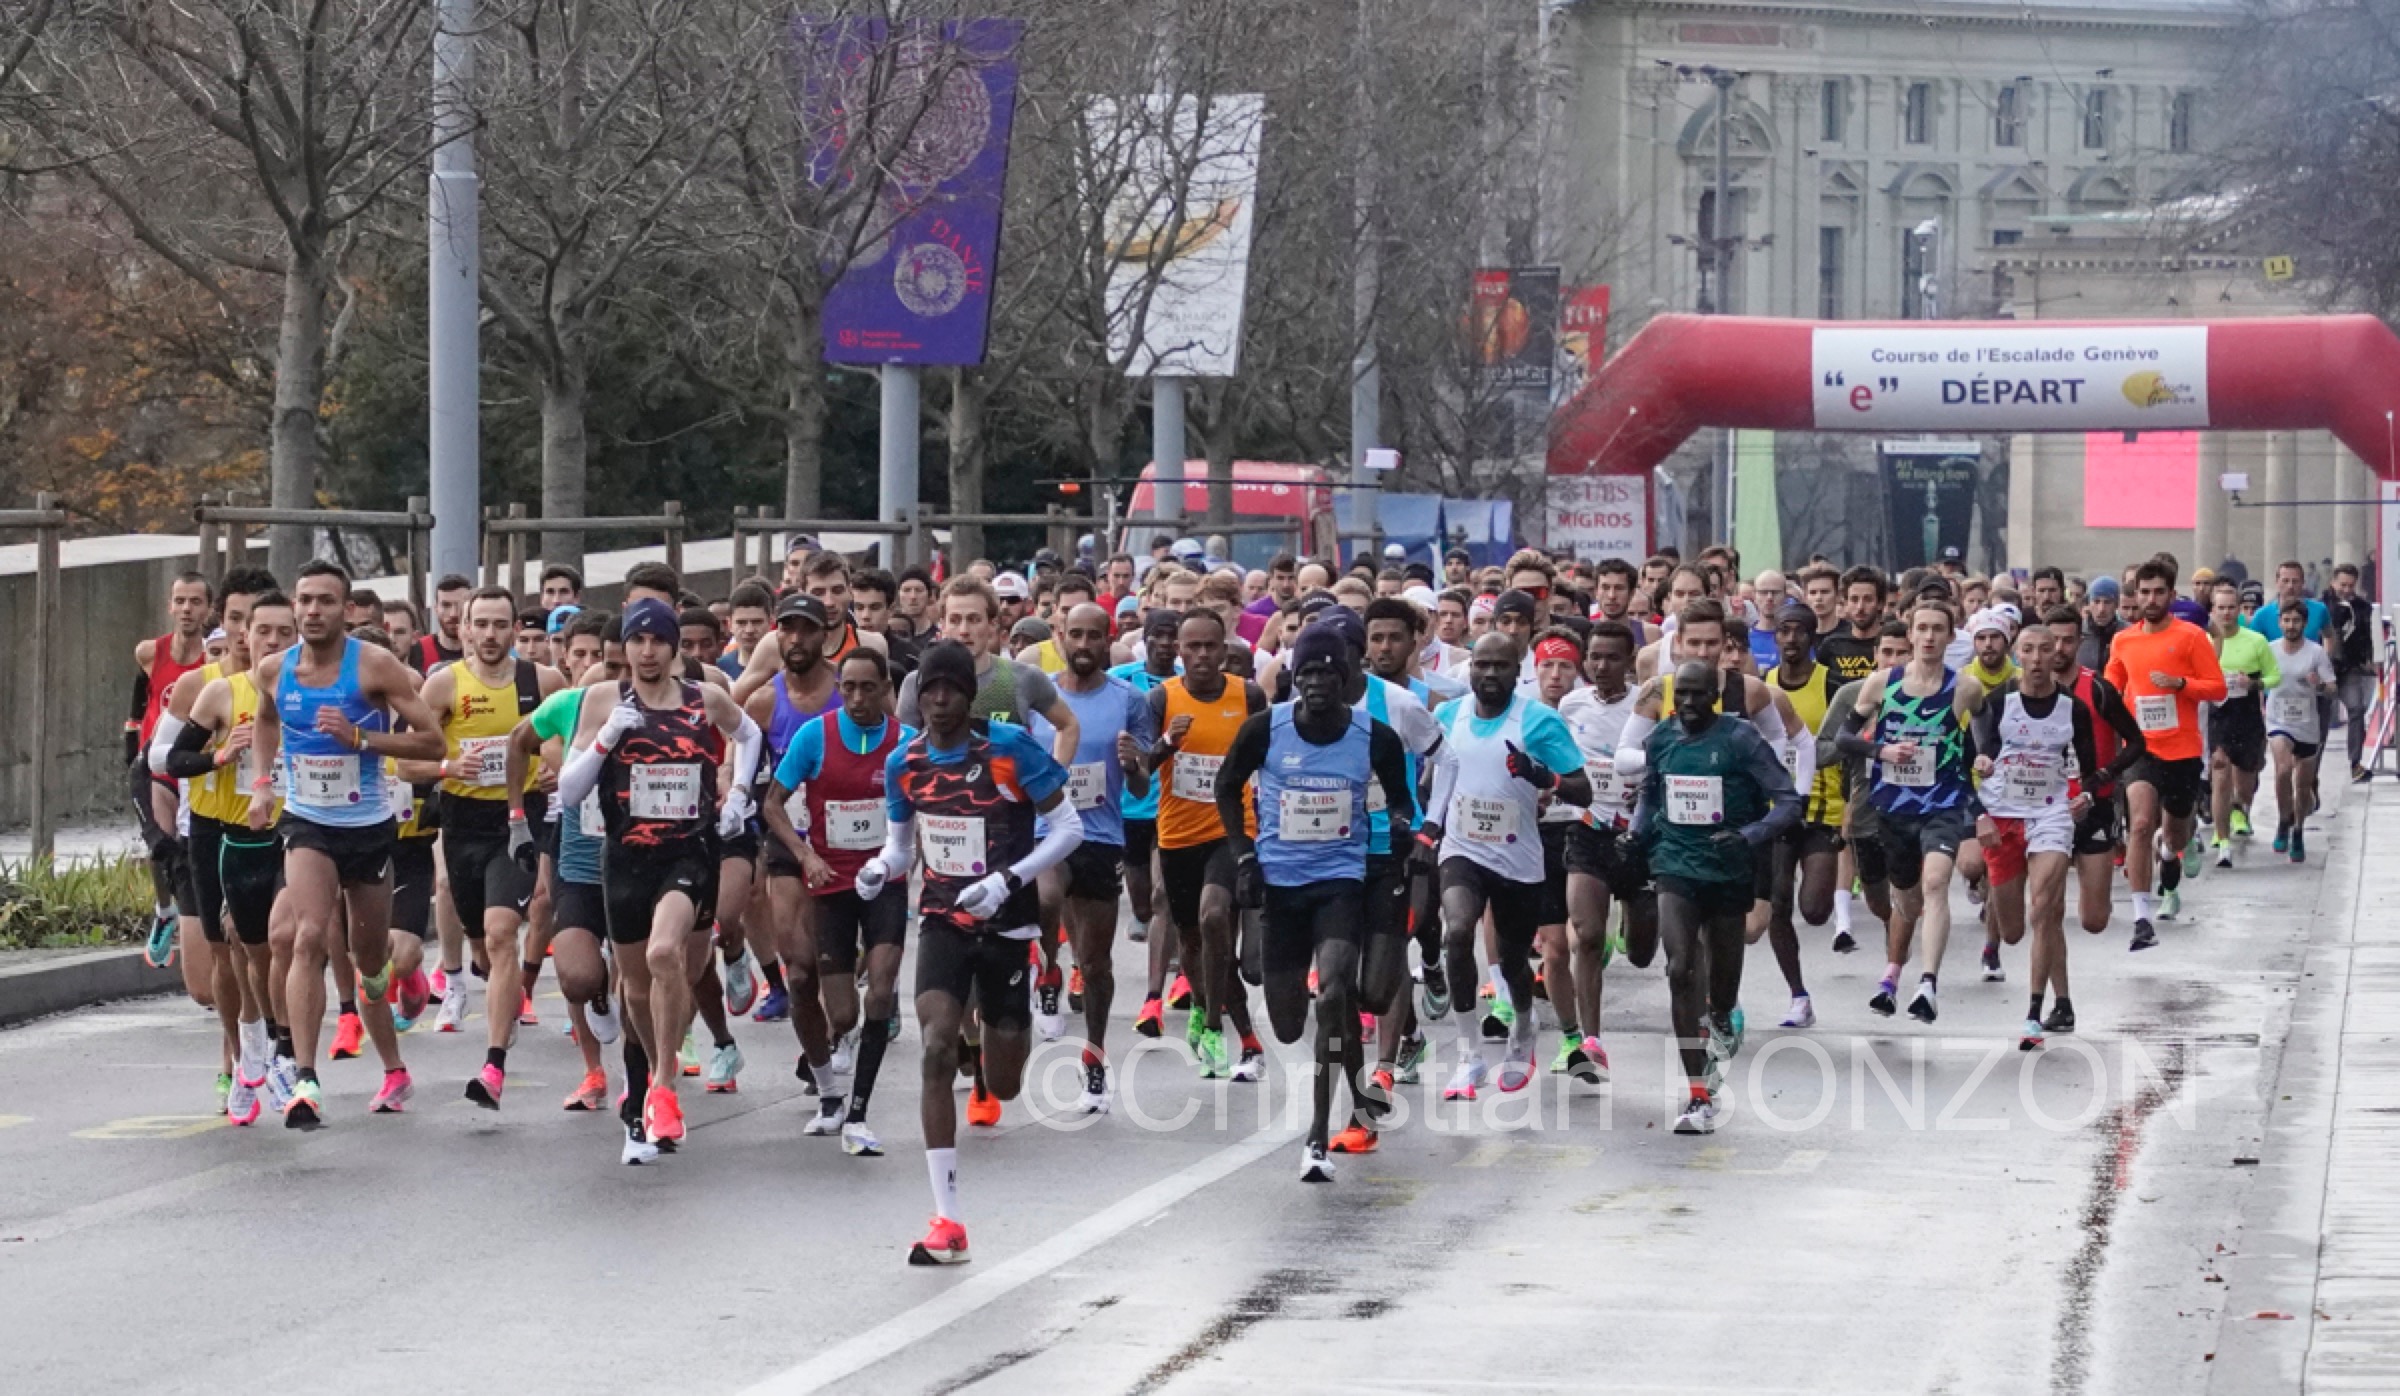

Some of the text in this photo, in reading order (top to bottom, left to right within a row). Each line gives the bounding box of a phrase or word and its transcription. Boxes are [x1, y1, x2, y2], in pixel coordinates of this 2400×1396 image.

[930, 219, 985, 294] DANTE
[1871, 345, 2160, 363] Course de l'Escalade Genève
[1941, 372, 2086, 405] DÉPART
[1558, 511, 1633, 529] MIGROS
[304, 758, 345, 769] MIGROS
[646, 768, 689, 777] MIGROS
[321, 782, 329, 793] 3
[664, 791, 671, 803] 1
[1311, 795, 1336, 805] UBS
[839, 800, 879, 812] MIGROS
[852, 819, 871, 833] 59
[927, 818, 968, 831] MIGROS
[1311, 817, 1320, 827] 4
[1478, 821, 1493, 832] 22
[943, 847, 951, 858] 5
